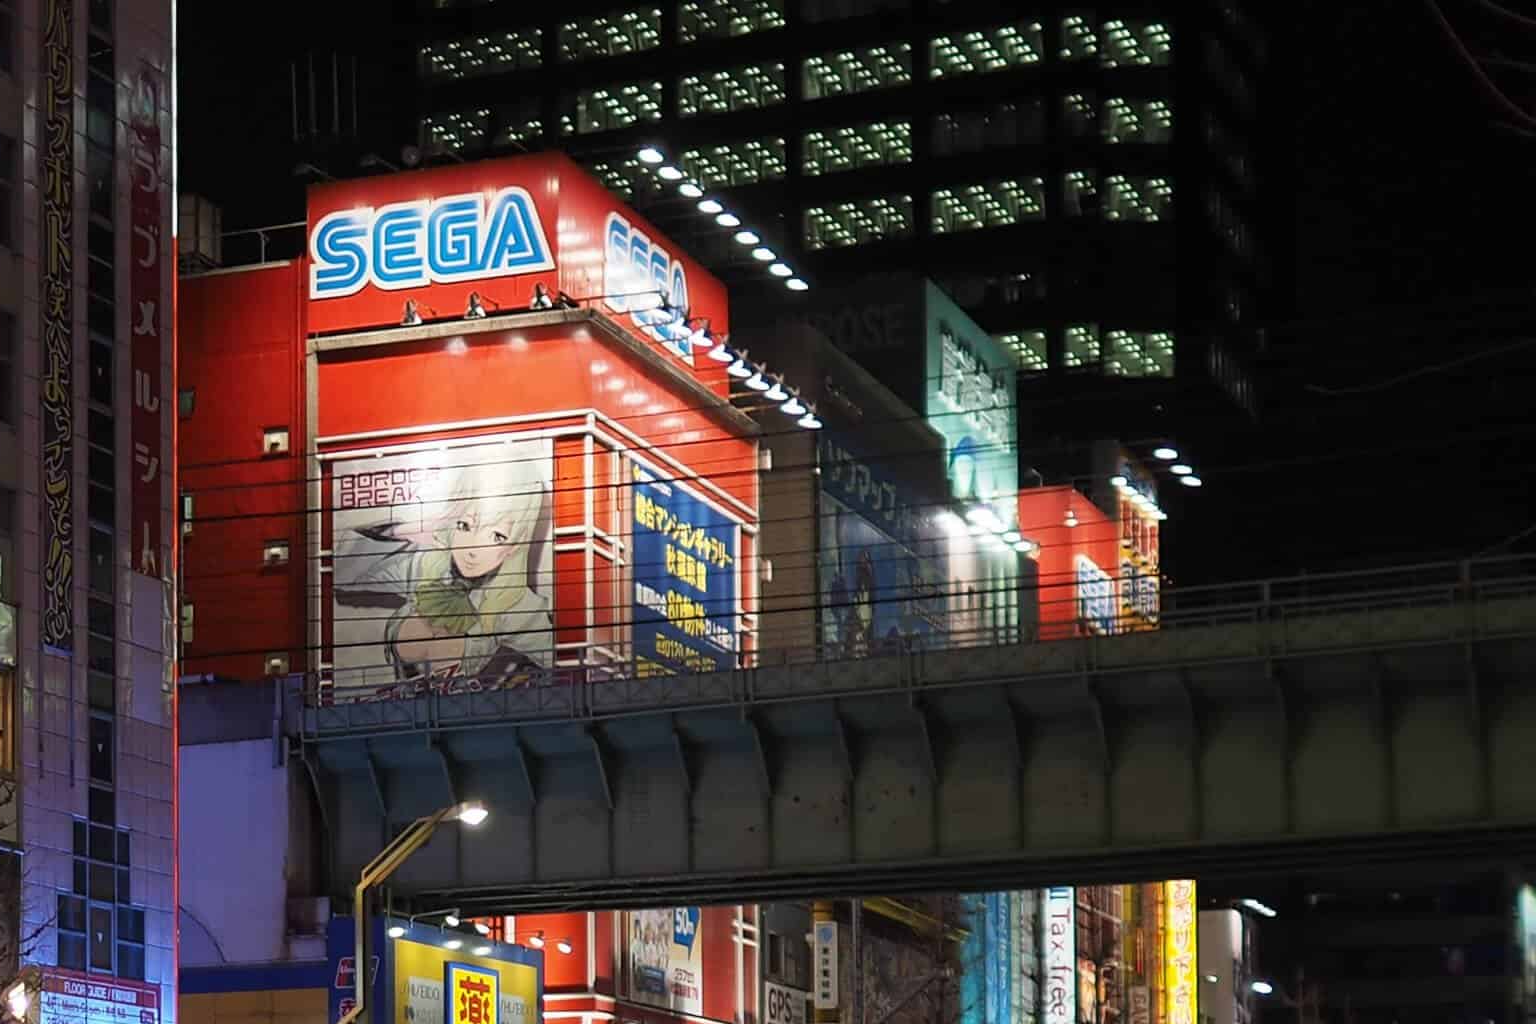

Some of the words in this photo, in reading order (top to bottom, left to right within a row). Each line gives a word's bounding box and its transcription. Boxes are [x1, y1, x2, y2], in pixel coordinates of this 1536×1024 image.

[311, 188, 554, 298] SEGA
[603, 211, 695, 365] SEGA
[767, 987, 793, 1023] GPS
[1049, 908, 1073, 1017] Tax-free
